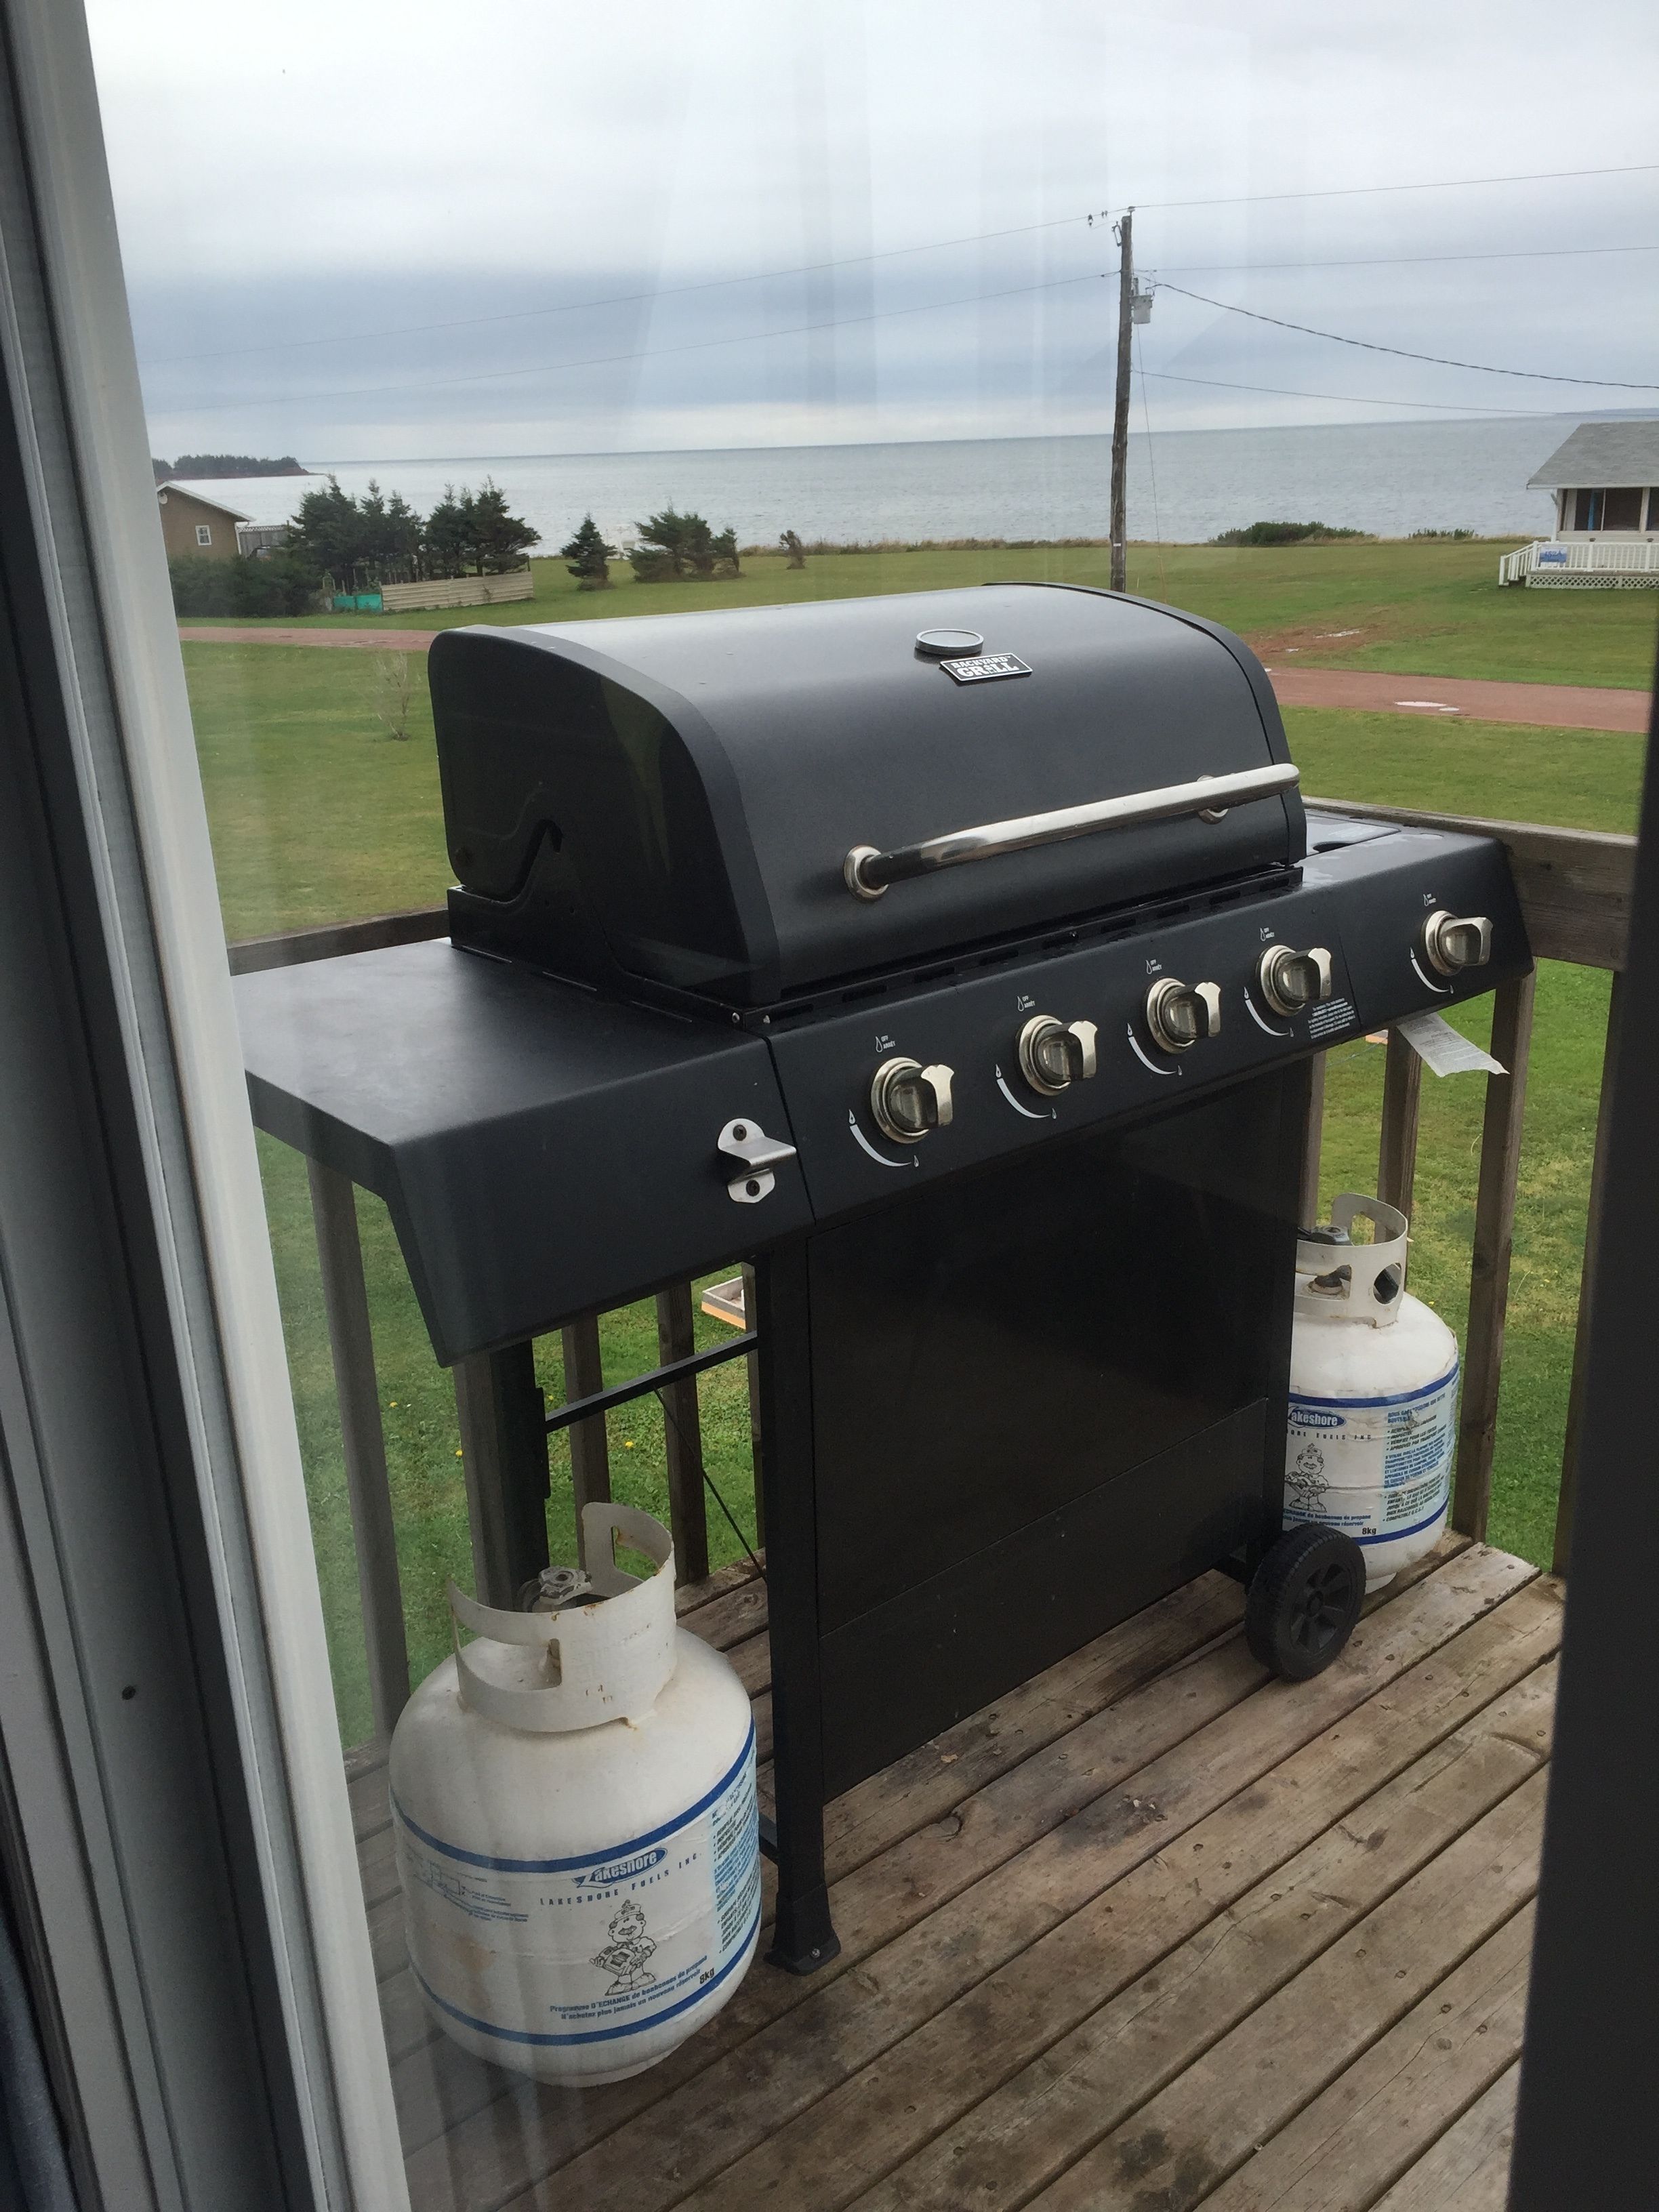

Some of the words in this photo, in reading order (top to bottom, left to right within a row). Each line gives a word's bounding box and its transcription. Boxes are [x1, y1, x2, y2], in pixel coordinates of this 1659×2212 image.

[951, 656, 1008, 668] BACKYARD
[957, 662, 1019, 677] GRILL
[540, 1889, 619, 1906] LAKESHORE
[632, 1869, 670, 1891] FUELS
[699, 1967, 715, 1985] 8kg
[632, 1992, 640, 2000] de
[678, 1970, 685, 1980] de
[597, 2008, 613, 2018] plus
[614, 2002, 636, 2013] jamais
